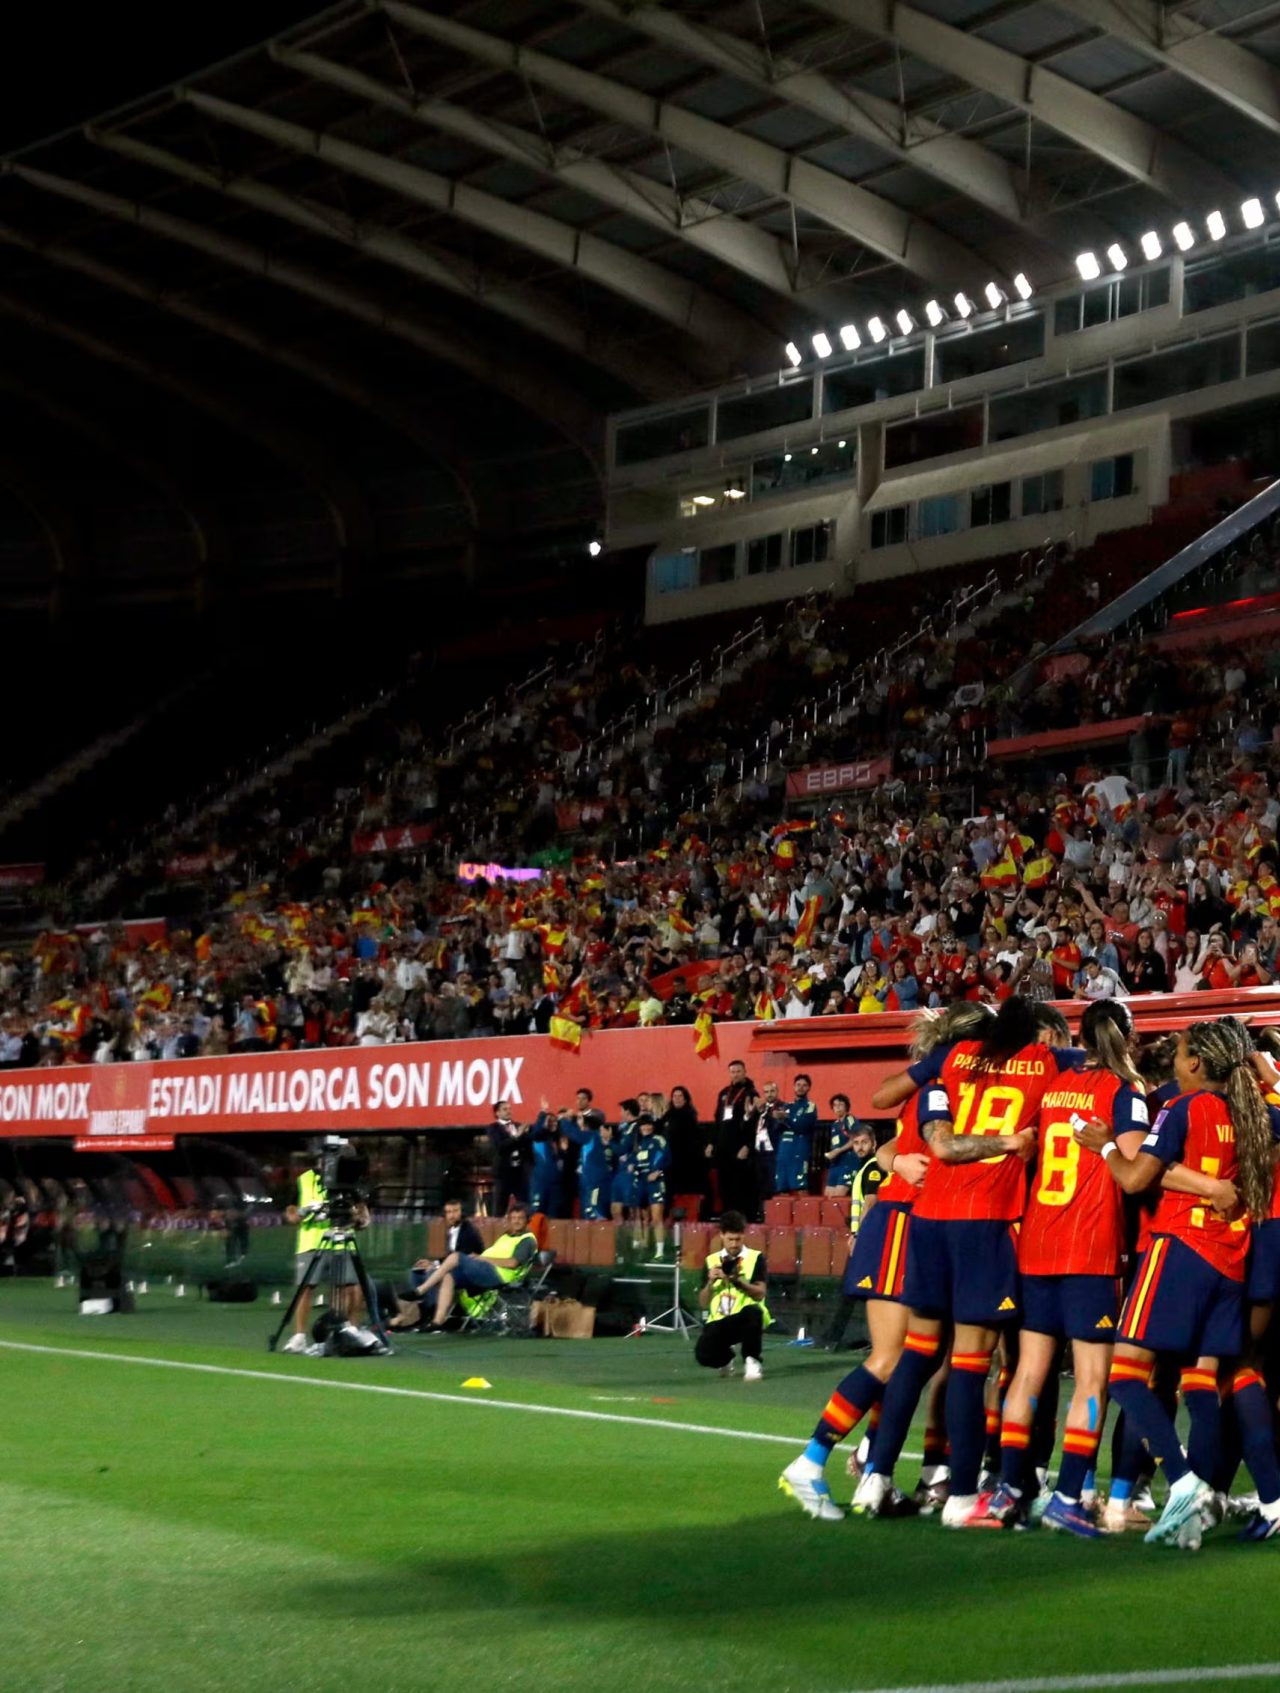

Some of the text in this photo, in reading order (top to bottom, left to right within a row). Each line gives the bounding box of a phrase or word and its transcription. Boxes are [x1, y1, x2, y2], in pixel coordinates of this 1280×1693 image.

[0, 1081, 91, 1121] ON MOIX
[149, 1056, 525, 1117] ESTADI MALLORCA SON MOIX
[1041, 1090, 1095, 1111] MARIONA
[953, 1082, 1024, 1164] 18
[1037, 1121, 1081, 1207] 8
